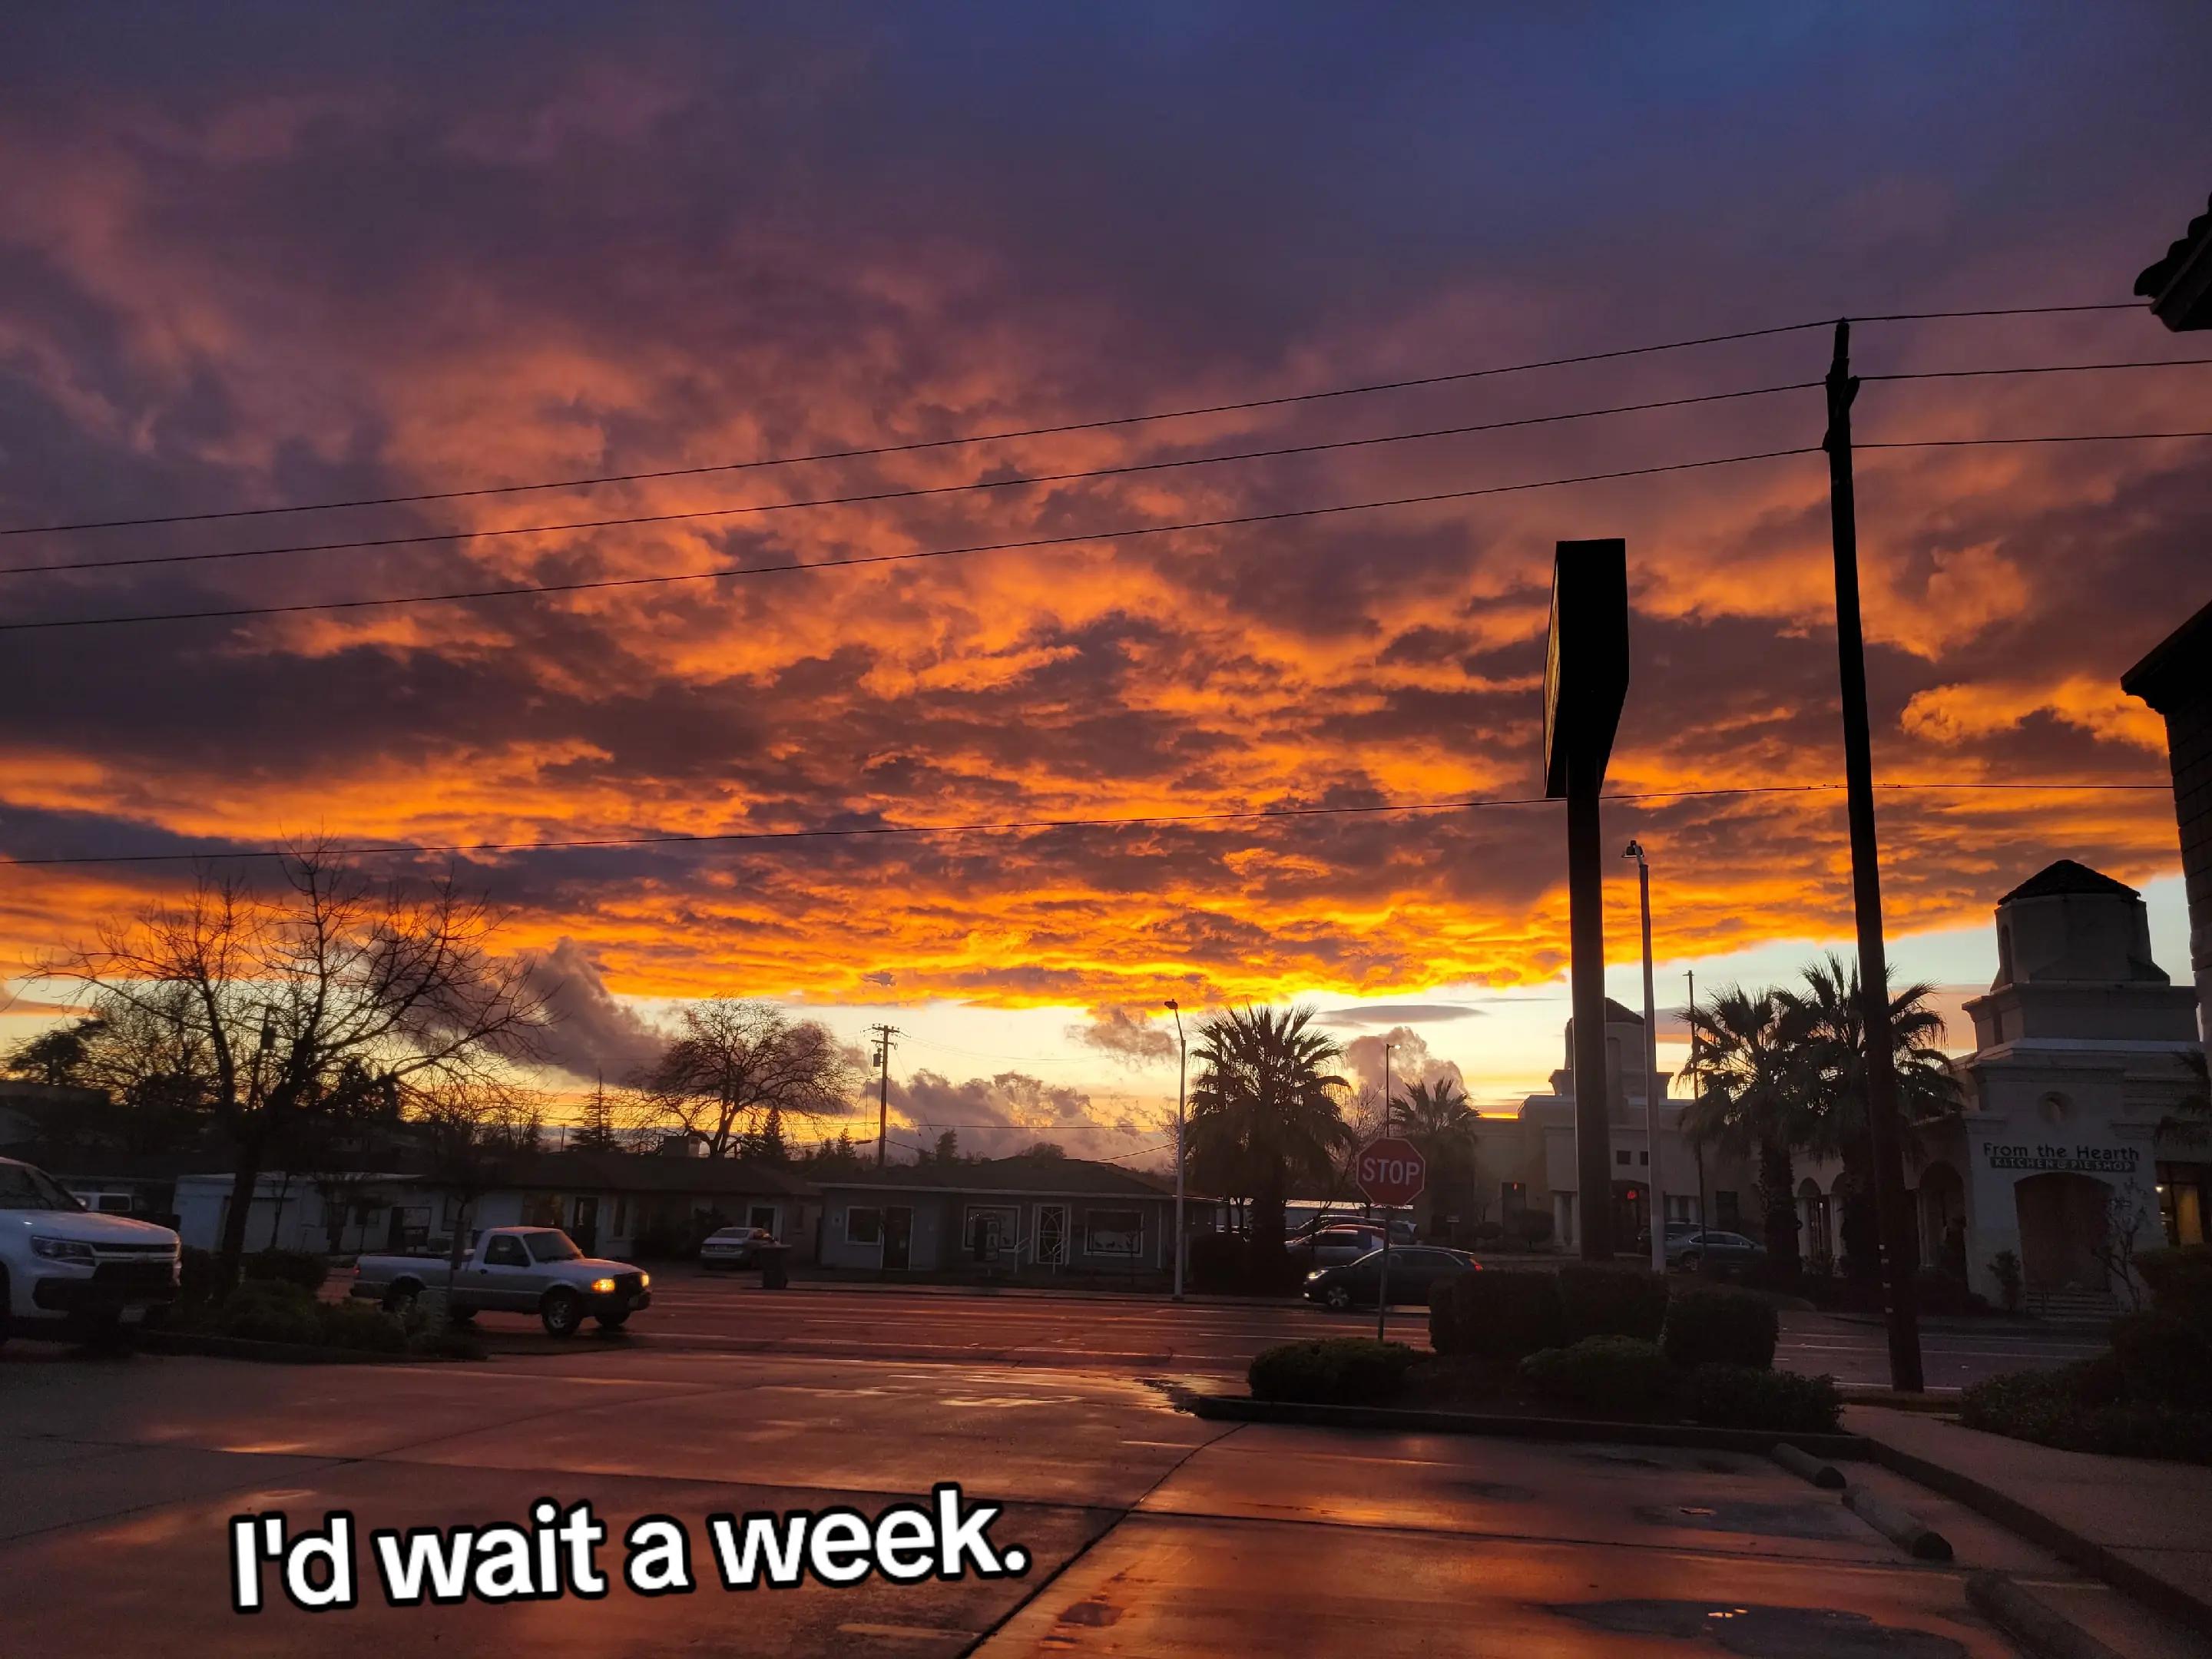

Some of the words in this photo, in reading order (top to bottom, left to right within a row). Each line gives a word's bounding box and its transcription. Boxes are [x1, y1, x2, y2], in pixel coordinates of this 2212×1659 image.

[1983, 1141, 2028, 1157] From
[2036, 1143, 2067, 1158] the
[2076, 1145, 2140, 1161] Hearth
[1362, 1157, 1420, 1186] STOP
[1995, 1158, 2054, 1168] KITCHEN
[2071, 1160, 2091, 1170] PIE
[2095, 1161, 2131, 1171] SHOP
